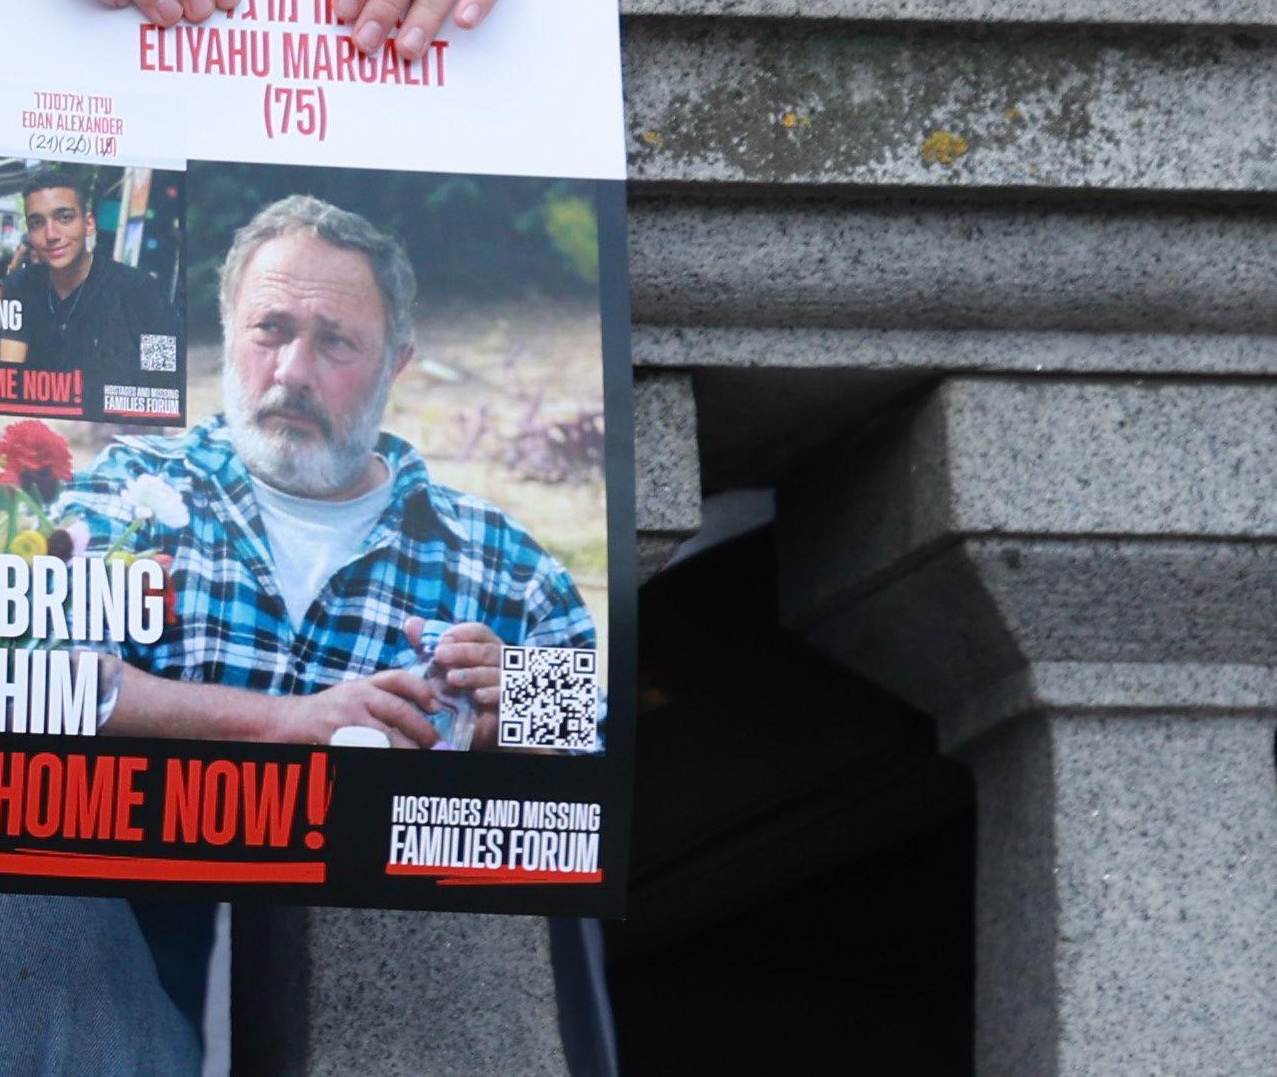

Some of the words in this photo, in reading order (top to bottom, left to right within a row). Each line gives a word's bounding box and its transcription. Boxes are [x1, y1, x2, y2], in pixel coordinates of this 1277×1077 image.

[139, 23, 271, 78] ELIYAHU
[22, 110, 53, 130] EDAN
[56, 113, 124, 136] ALEXANDER
[263, 83, 329, 142] (75)
[22, 368, 83, 404] NOW!
[104, 395, 145, 412] FAMILIES
[146, 398, 180, 415] FORUM
[162, 752, 330, 851] NOW!
[392, 795, 482, 827] HOSTAGES
[483, 799, 521, 828] AND
[521, 800, 602, 832] MISSING
[389, 824, 505, 870] FAMILIES
[508, 829, 600, 874] FORUM
